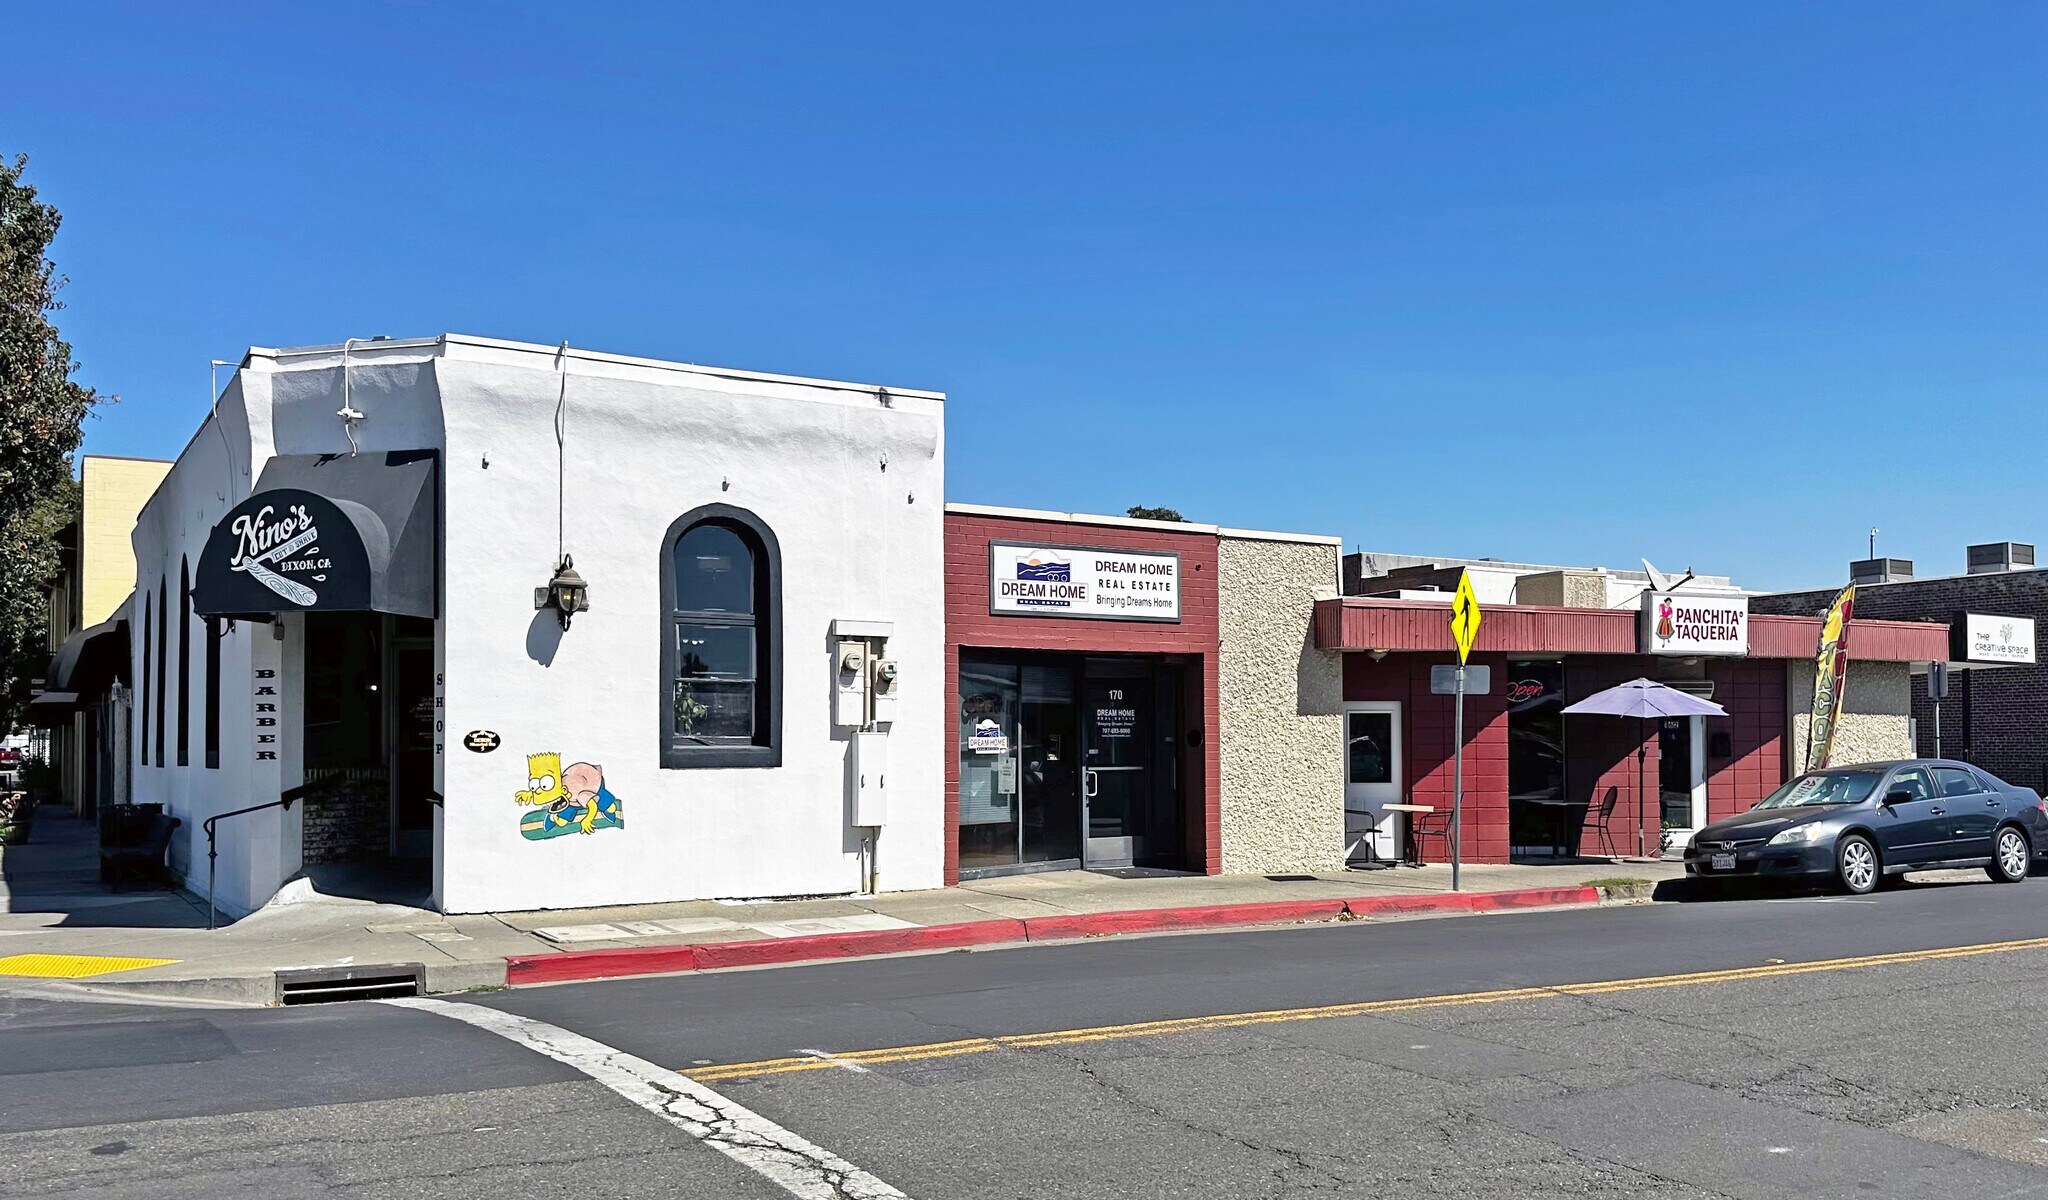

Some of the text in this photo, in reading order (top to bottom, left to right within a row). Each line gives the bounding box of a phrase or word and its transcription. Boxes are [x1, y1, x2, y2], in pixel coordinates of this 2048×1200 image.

[231, 505, 313, 566] Nino's
[281, 558, 332, 571] DIXON, CA
[1095, 560, 1173, 576] DREAM HOME
[1001, 582, 1086, 600] DREAM HOME
[1098, 578, 1171, 592] REAL ESTATE
[1096, 593, 1173, 608] Bringing Dreams Home
[1675, 624, 1739, 642] TAQUERIA
[1109, 689, 1123, 700] 170
[254, 669, 277, 760] BARBER
[435, 673, 444, 754] SHOP
[1096, 709, 1135, 717] DREAM HOME
[969, 738, 1006, 747] DREAM HOME
